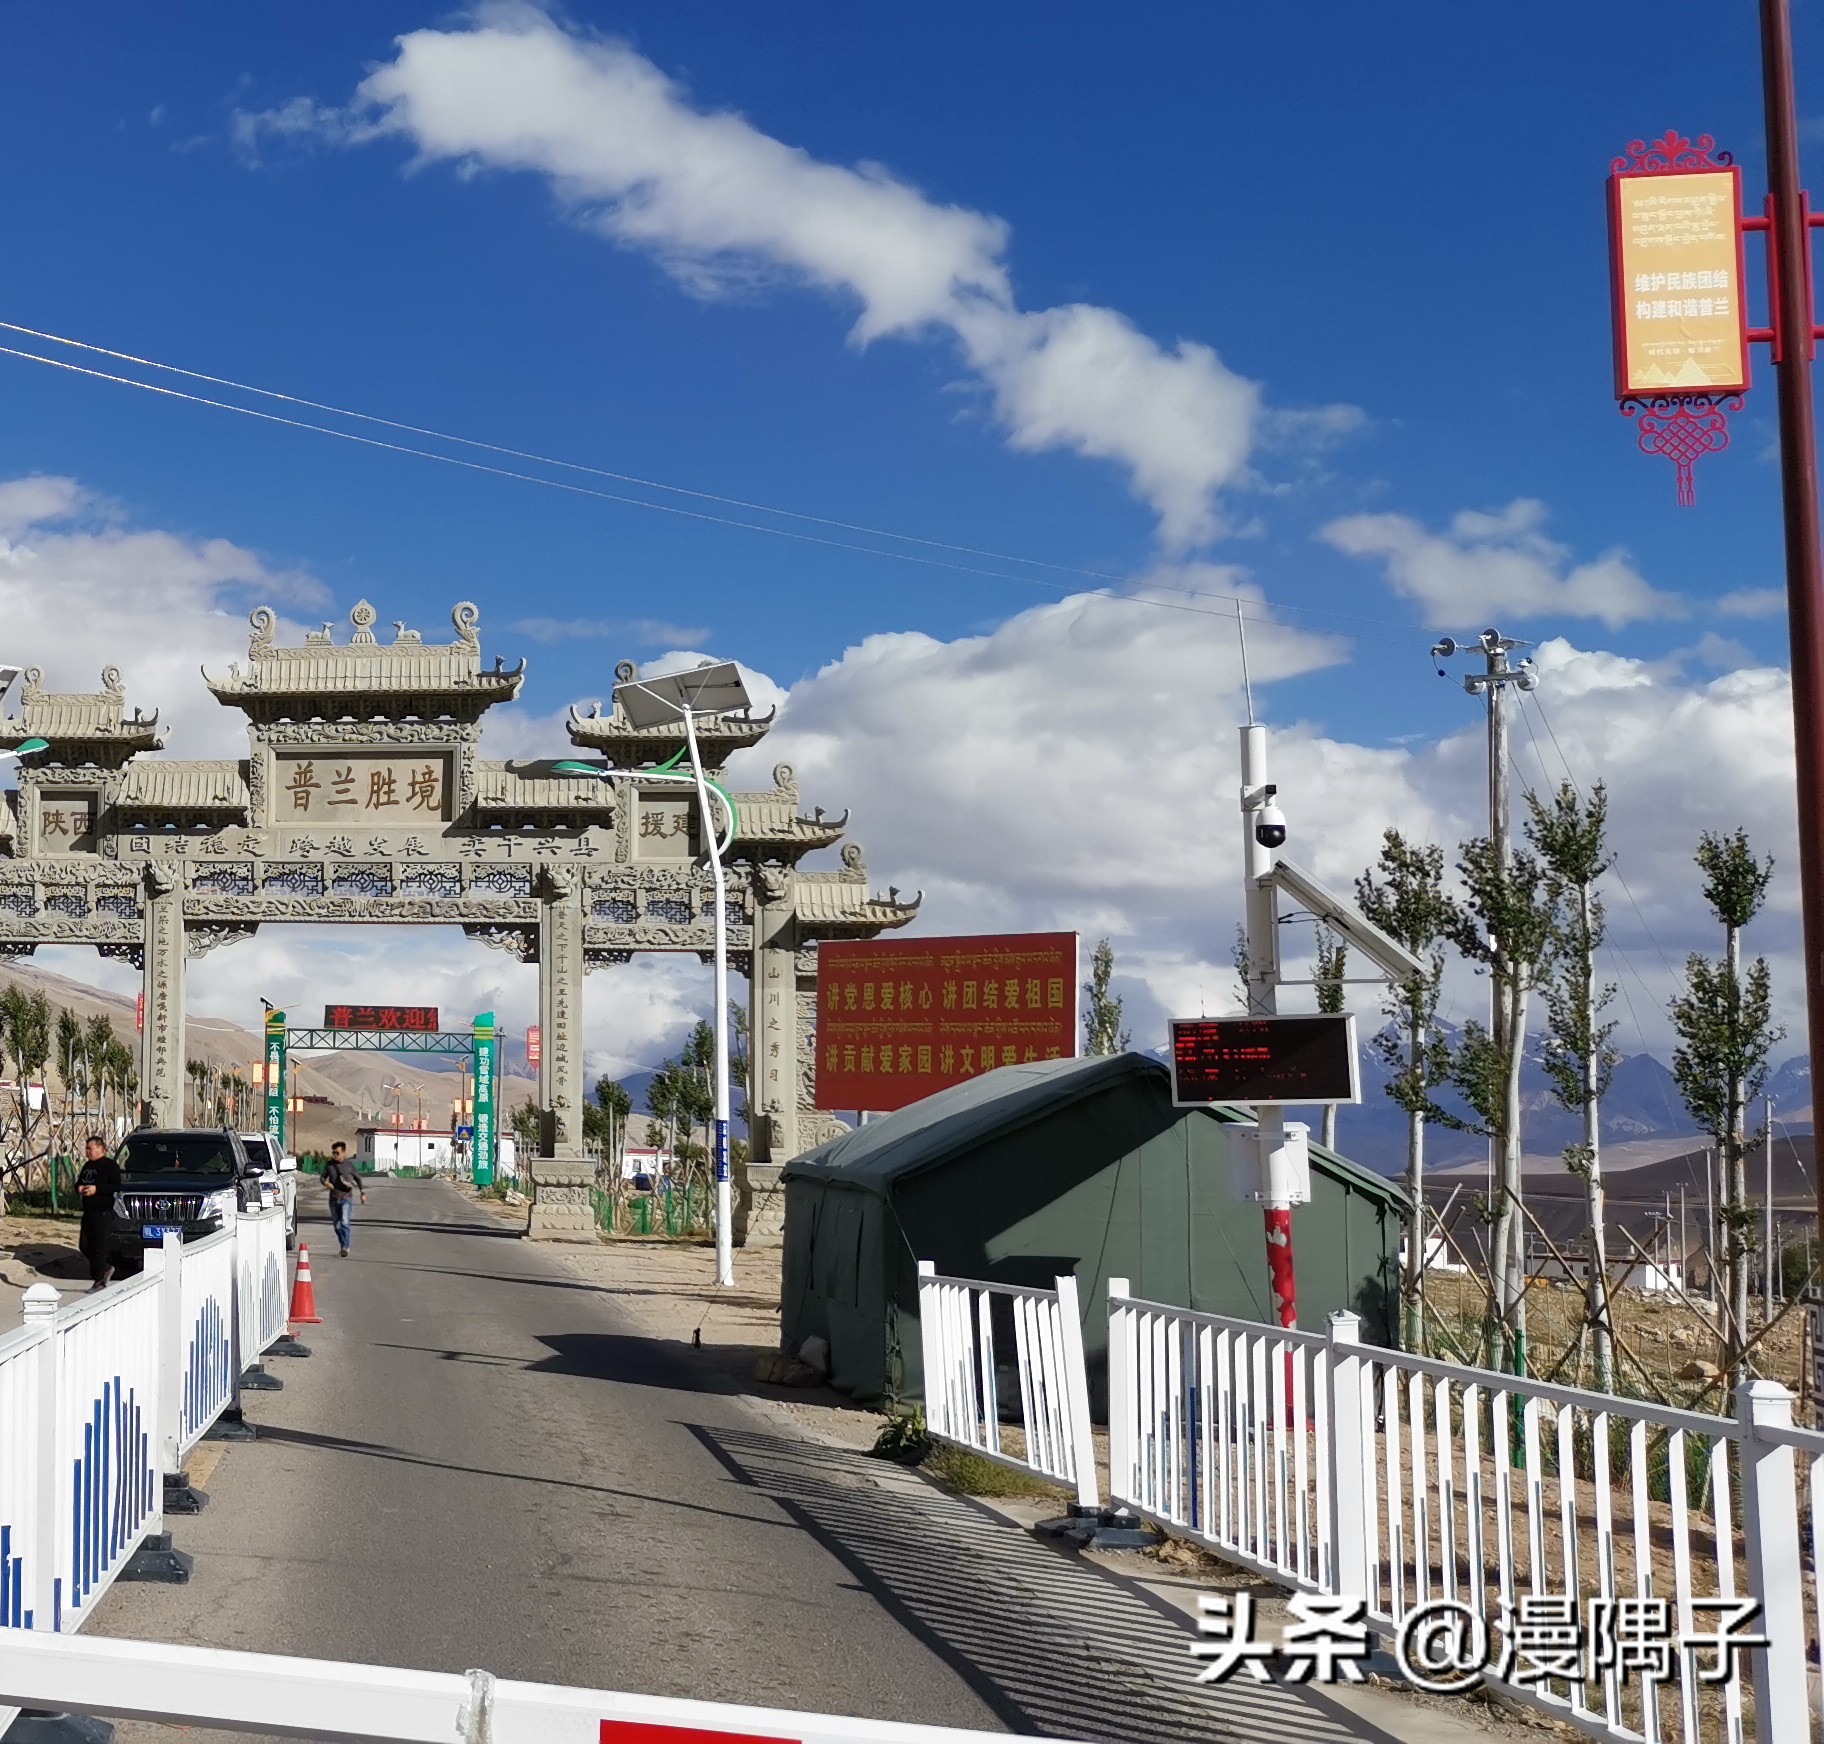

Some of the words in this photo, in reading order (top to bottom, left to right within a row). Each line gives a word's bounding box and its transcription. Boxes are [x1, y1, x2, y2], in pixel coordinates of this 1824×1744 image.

[1634, 270, 1728, 293] 维护民族团结
[1636, 297, 1730, 320] 构建和谐普兰
[284, 761, 445, 811] 普兰胜境
[42, 809, 97, 836] 陕西
[639, 811, 697, 839] 援建
[826, 980, 933, 1011] 讲党恩爱核心
[942, 978, 1064, 1010] 讲团结爱祖国
[825, 1044, 932, 1075] 讲贡献爱家园
